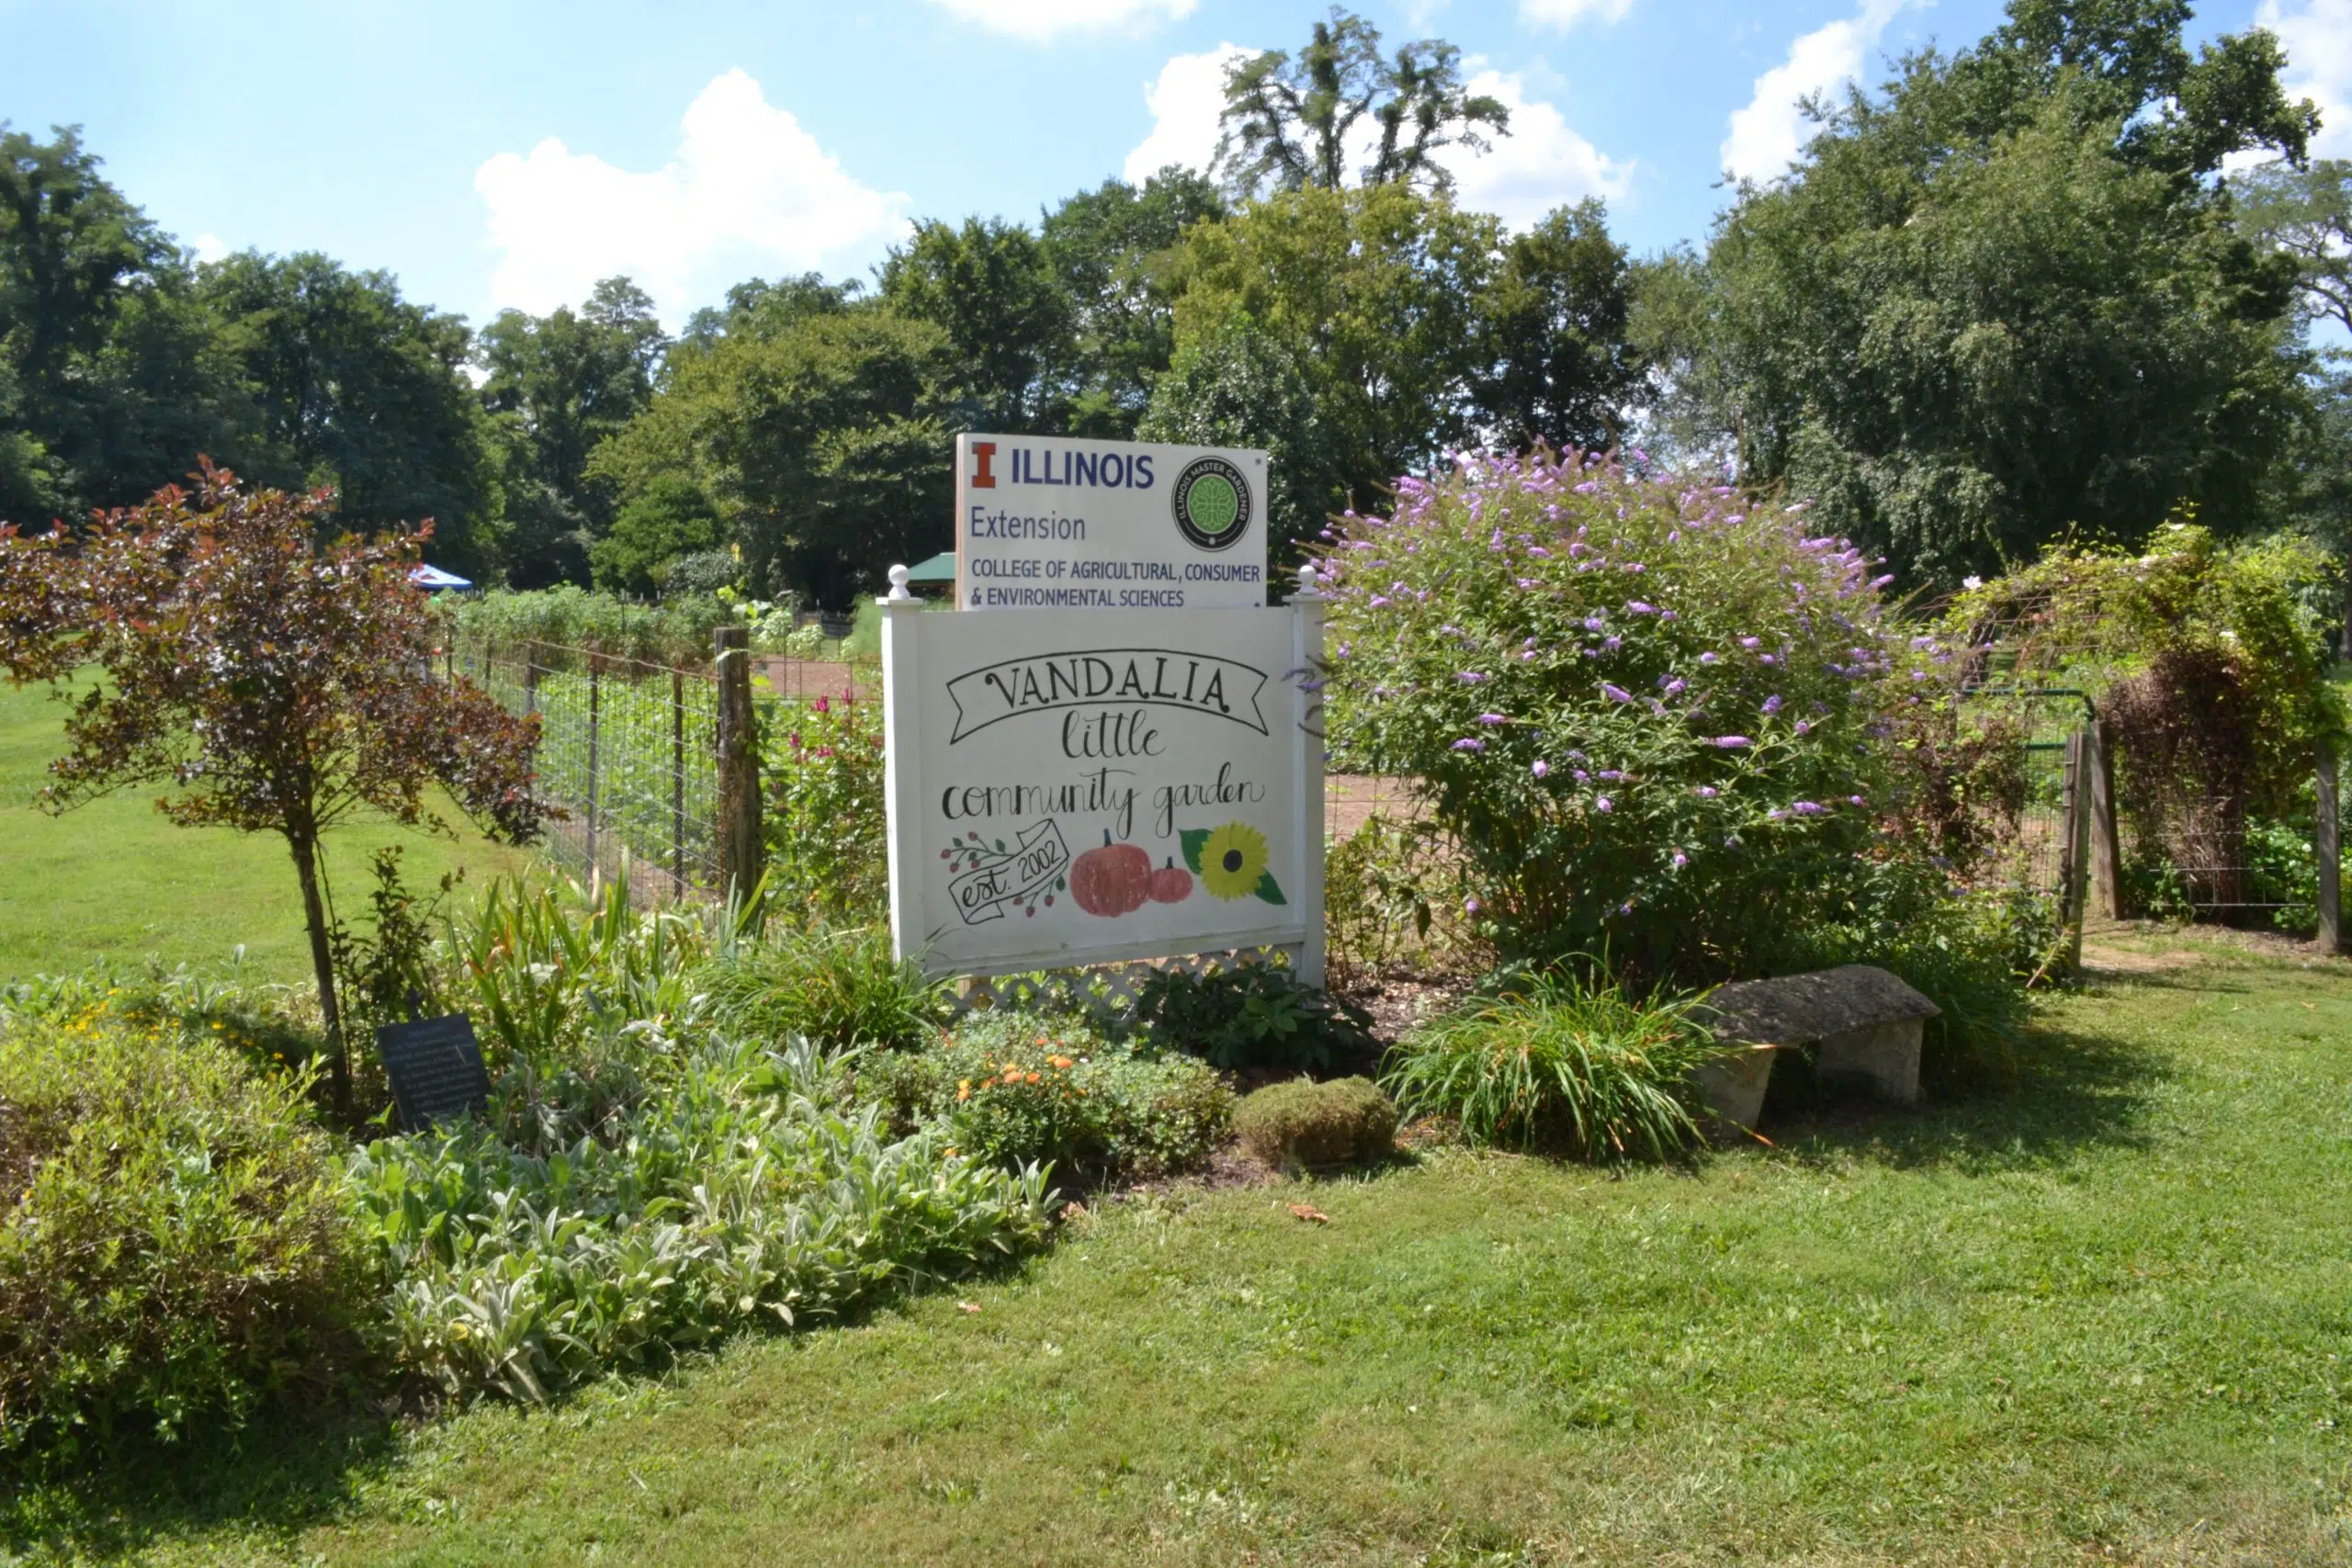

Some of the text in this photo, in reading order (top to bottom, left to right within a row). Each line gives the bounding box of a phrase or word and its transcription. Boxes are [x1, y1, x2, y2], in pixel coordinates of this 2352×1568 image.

[1012, 448, 1155, 490] ILLINOIS
[1177, 462, 1248, 522] ILLINOIS MASTER GARDENER
[970, 506, 1086, 540] Extension
[971, 558, 1261, 583] COLLEGE OF AGRICULTURAL, CONSUMER
[970, 587, 1184, 607] & ENVIRONMENTAL SCIENCES
[984, 657, 1230, 714] VANDALIA
[1062, 709, 1166, 758] little
[942, 761, 1265, 840] community garden
[962, 840, 1060, 908] est. 2002
